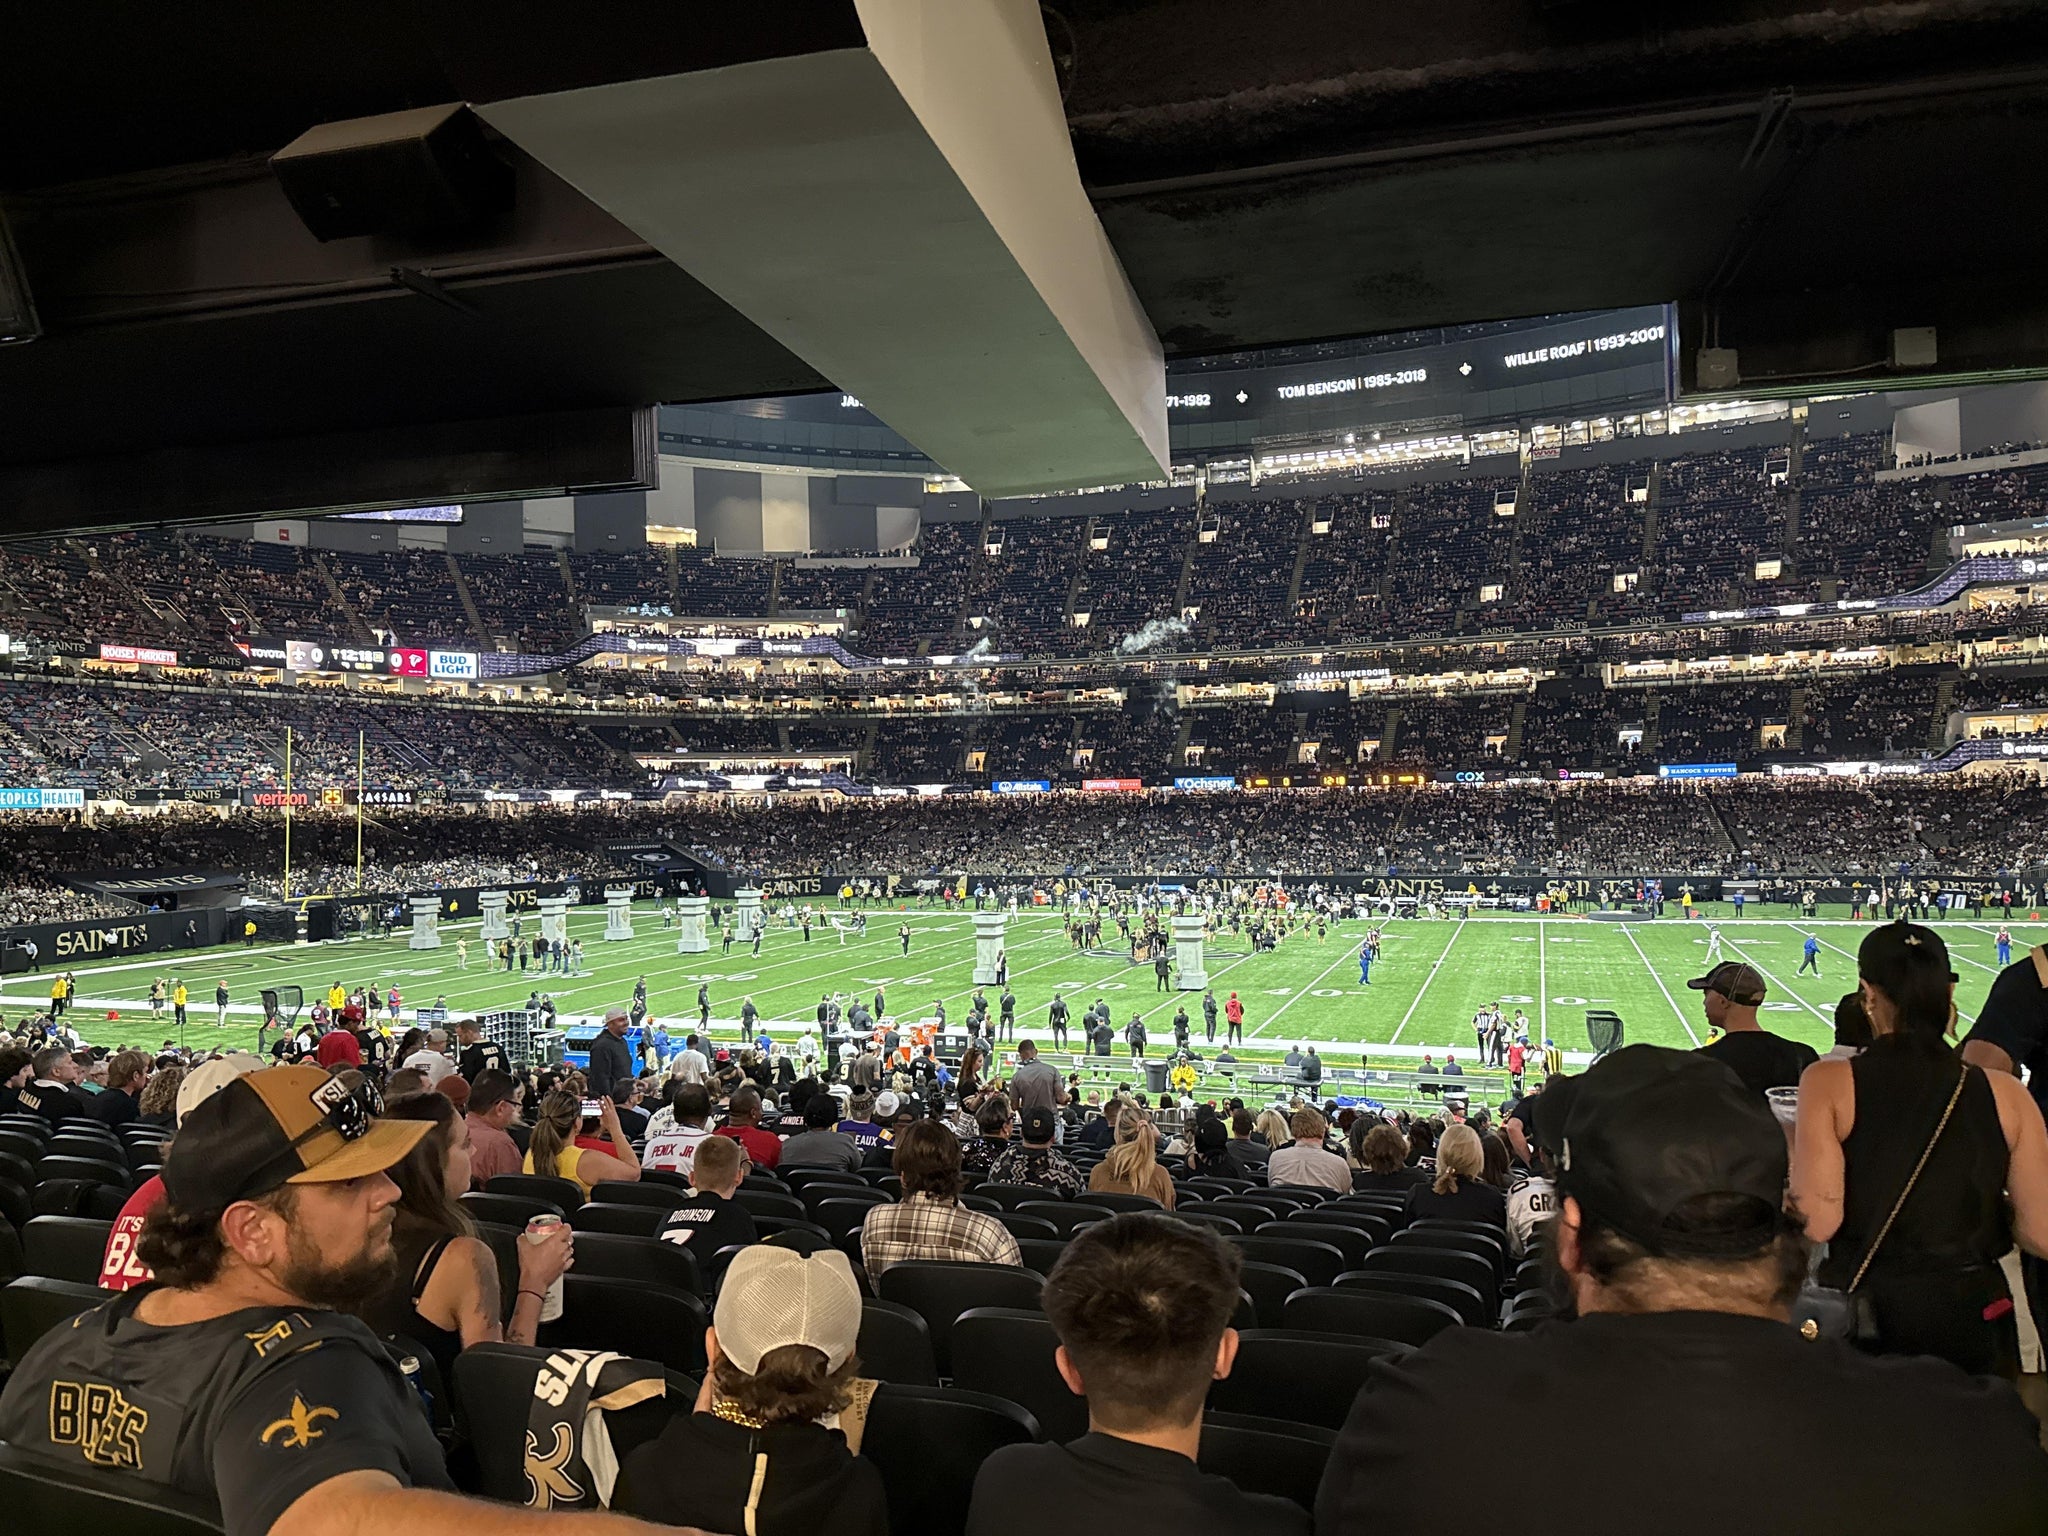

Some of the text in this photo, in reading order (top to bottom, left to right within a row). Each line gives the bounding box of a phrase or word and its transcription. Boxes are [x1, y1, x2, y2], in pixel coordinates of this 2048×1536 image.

[1504, 325, 1665, 368] WILLIE ROAF 1993-2001
[1277, 368, 1427, 399] TOM BENSON 1985-2018
[1166, 394, 1211, 407] 71-1982
[1553, 621, 1588, 631] SAINTS
[1630, 616, 1665, 625] SAINTS
[1481, 626, 1514, 635] SAINTS
[2008, 624, 2047, 635] SAINTS
[1341, 636, 1373, 644] SAINTS
[1409, 631, 1442, 640] SAINTS
[1916, 631, 1955, 642] SAINTS
[48, 640, 86, 652] SAINTS
[1833, 639, 1869, 648] SAINTS
[102, 646, 176, 663] ROUSES MARKETS
[251, 648, 286, 659] TOYOTA
[311, 648, 323, 663] 0
[1029, 652, 1056, 660] SAINTS
[208, 656, 242, 666] SAINTS
[390, 653, 403, 668] 0
[440, 655, 467, 665] BUD
[434, 664, 473, 675] LIGHT
[1296, 668, 1390, 680] CAESARS SUPERDOME
[1456, 771, 1485, 782] COX
[1570, 771, 1604, 779] entergy
[1012, 782, 1043, 791] Allstate
[1185, 778, 1233, 789] Ochsner
[44, 792, 81, 805] HEALTH
[96, 790, 137, 800] SAINTS
[184, 789, 222, 799] SAINTS
[253, 791, 308, 806] verizon
[417, 790, 446, 799] SAINTS
[95, 874, 207, 889] SAINTS
[1362, 878, 1445, 896] SAINTS
[770, 1068, 780, 1084] 7
[840, 1064, 850, 1080] 9
[780, 1115, 805, 1126] SANDER
[855, 1134, 878, 1147] EAUX
[652, 1144, 677, 1158] PENIX
[668, 1209, 716, 1224] ROBINSON
[117, 1215, 145, 1232] IT'S
